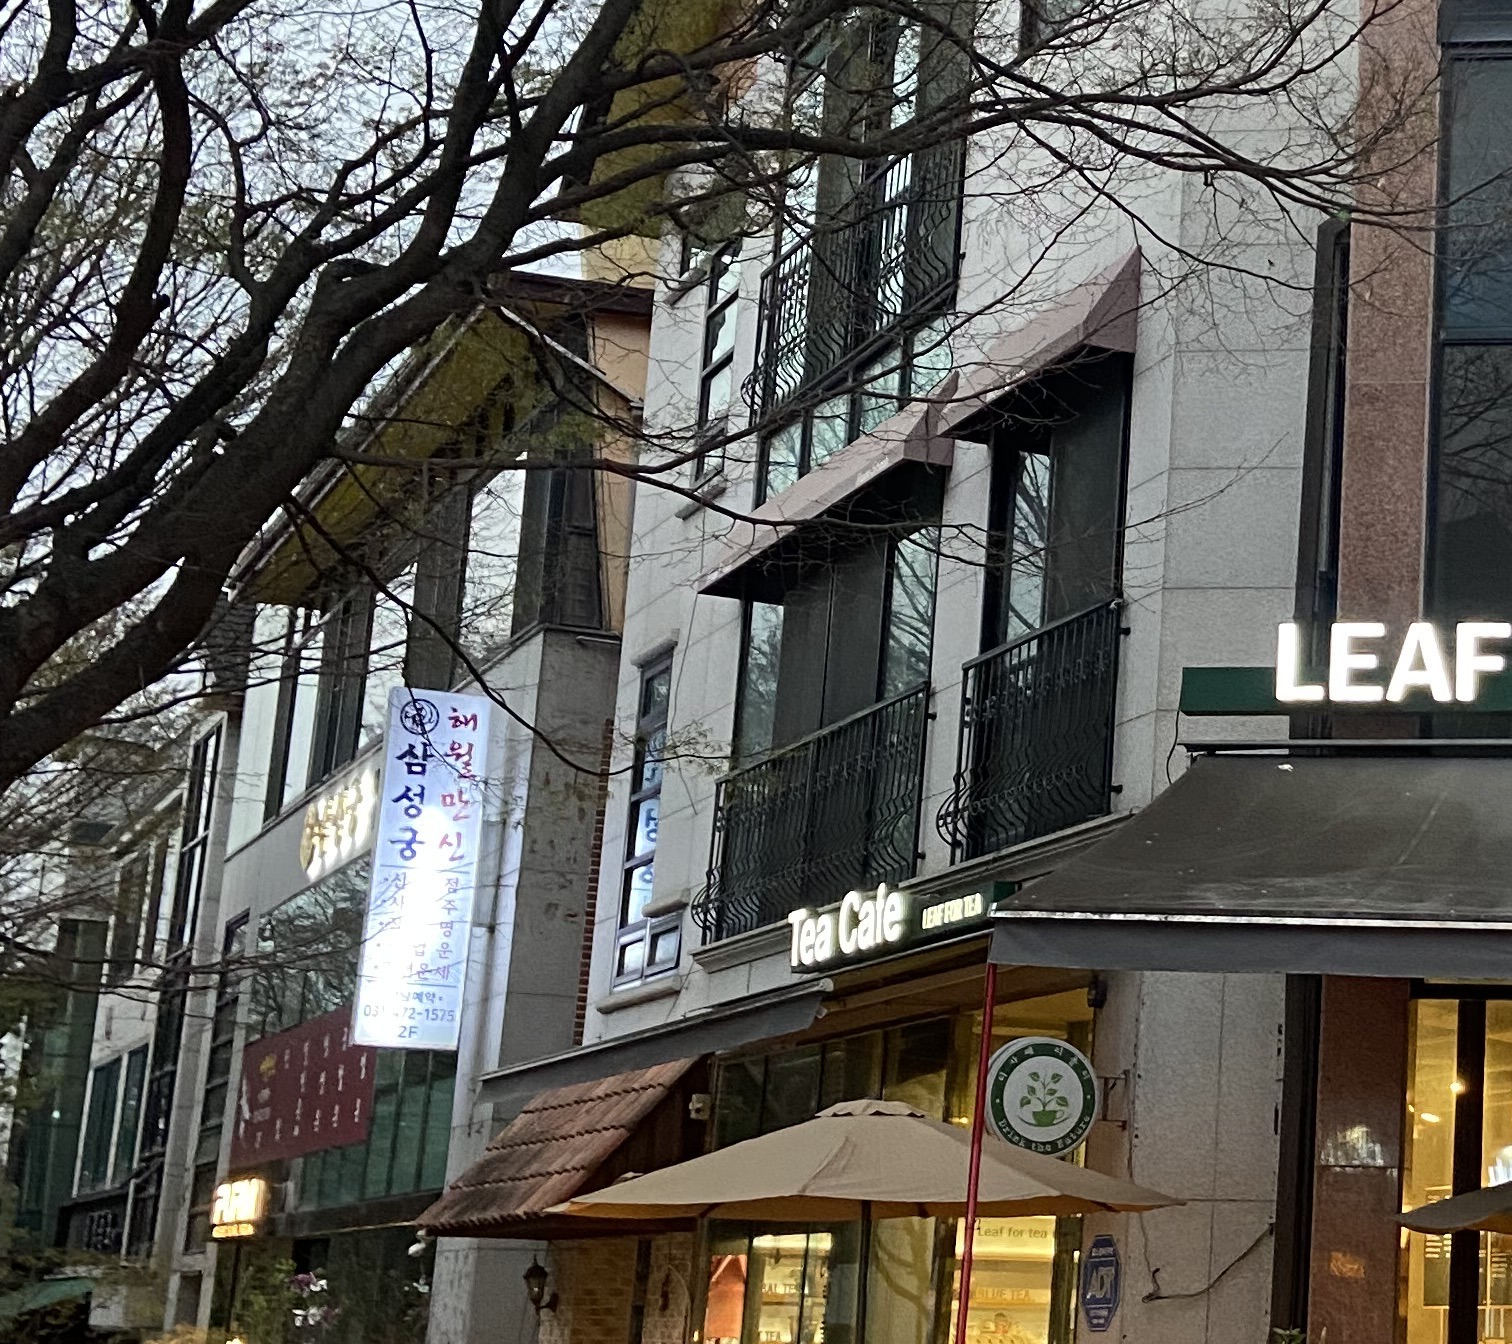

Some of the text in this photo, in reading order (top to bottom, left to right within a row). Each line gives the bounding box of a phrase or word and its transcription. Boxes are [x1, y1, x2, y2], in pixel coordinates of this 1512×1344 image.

[1275, 621, 1512, 703] LEAF
[388, 741, 428, 862] 삼성궁
[788, 882, 902, 967] Tea Cafe
[922, 892, 983, 930] LEAF FOR TEA
[397, 1025, 419, 1039] 2F
[998, 1117, 1026, 1147] Drink
[1031, 1141, 1052, 1152] the
[977, 1226, 1048, 1238] Leaf for tea
[1086, 1266, 1114, 1299] ADT
